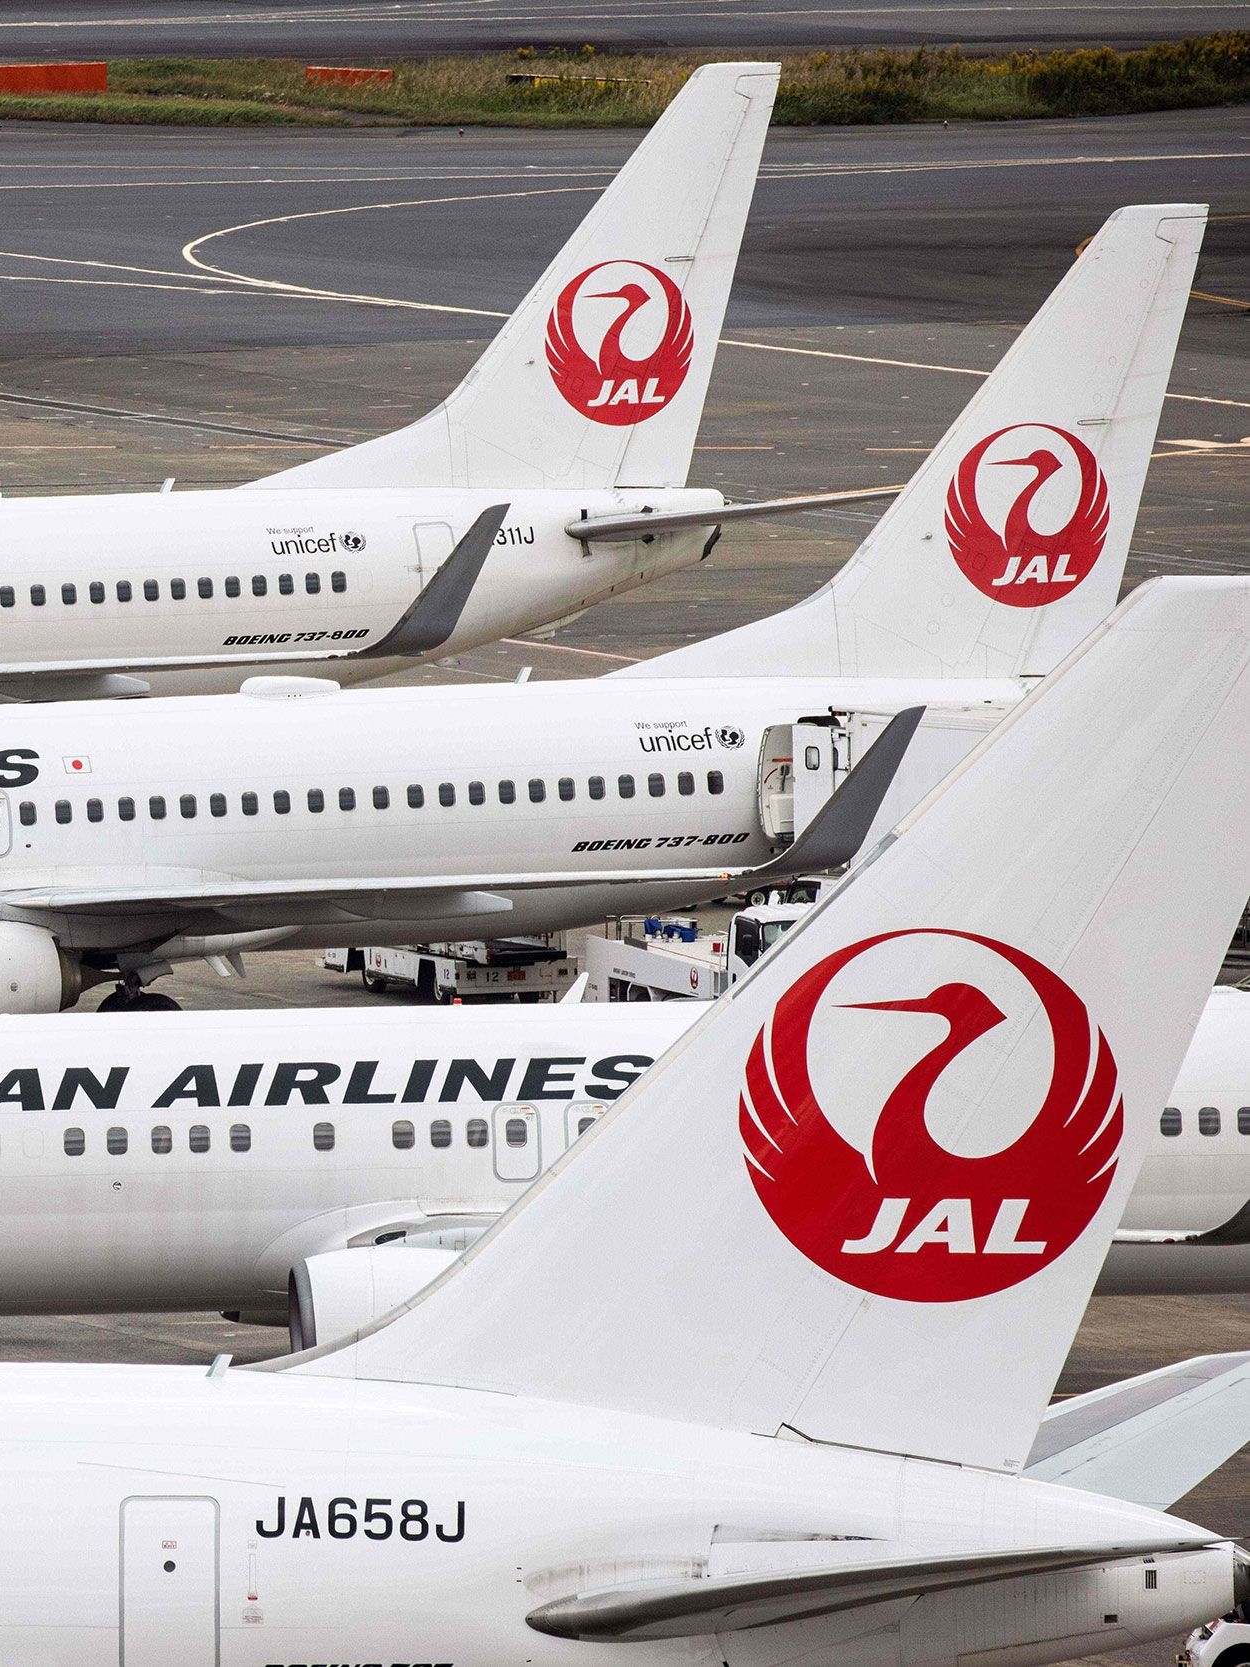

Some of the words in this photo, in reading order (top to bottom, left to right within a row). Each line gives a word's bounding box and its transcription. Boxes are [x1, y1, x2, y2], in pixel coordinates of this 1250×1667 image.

[587, 378, 665, 407] JAL
[266, 528, 280, 536] We
[283, 525, 315, 538] support
[492, 526, 535, 545] 311J
[270, 532, 337, 556] unicef
[992, 554, 1078, 586] JAL
[222, 633, 291, 646] BOEING
[293, 628, 370, 643] 737-800
[634, 721, 651, 731] We
[652, 719, 688, 732] support
[638, 725, 713, 753] unicef
[570, 837, 652, 853] BOEING
[654, 833, 750, 847] 737-800
[486, 971, 499, 982] 12
[151, 1054, 655, 1109] AIRLINES
[841, 1198, 1047, 1255] JAL
[255, 1496, 466, 1543] JA658J
